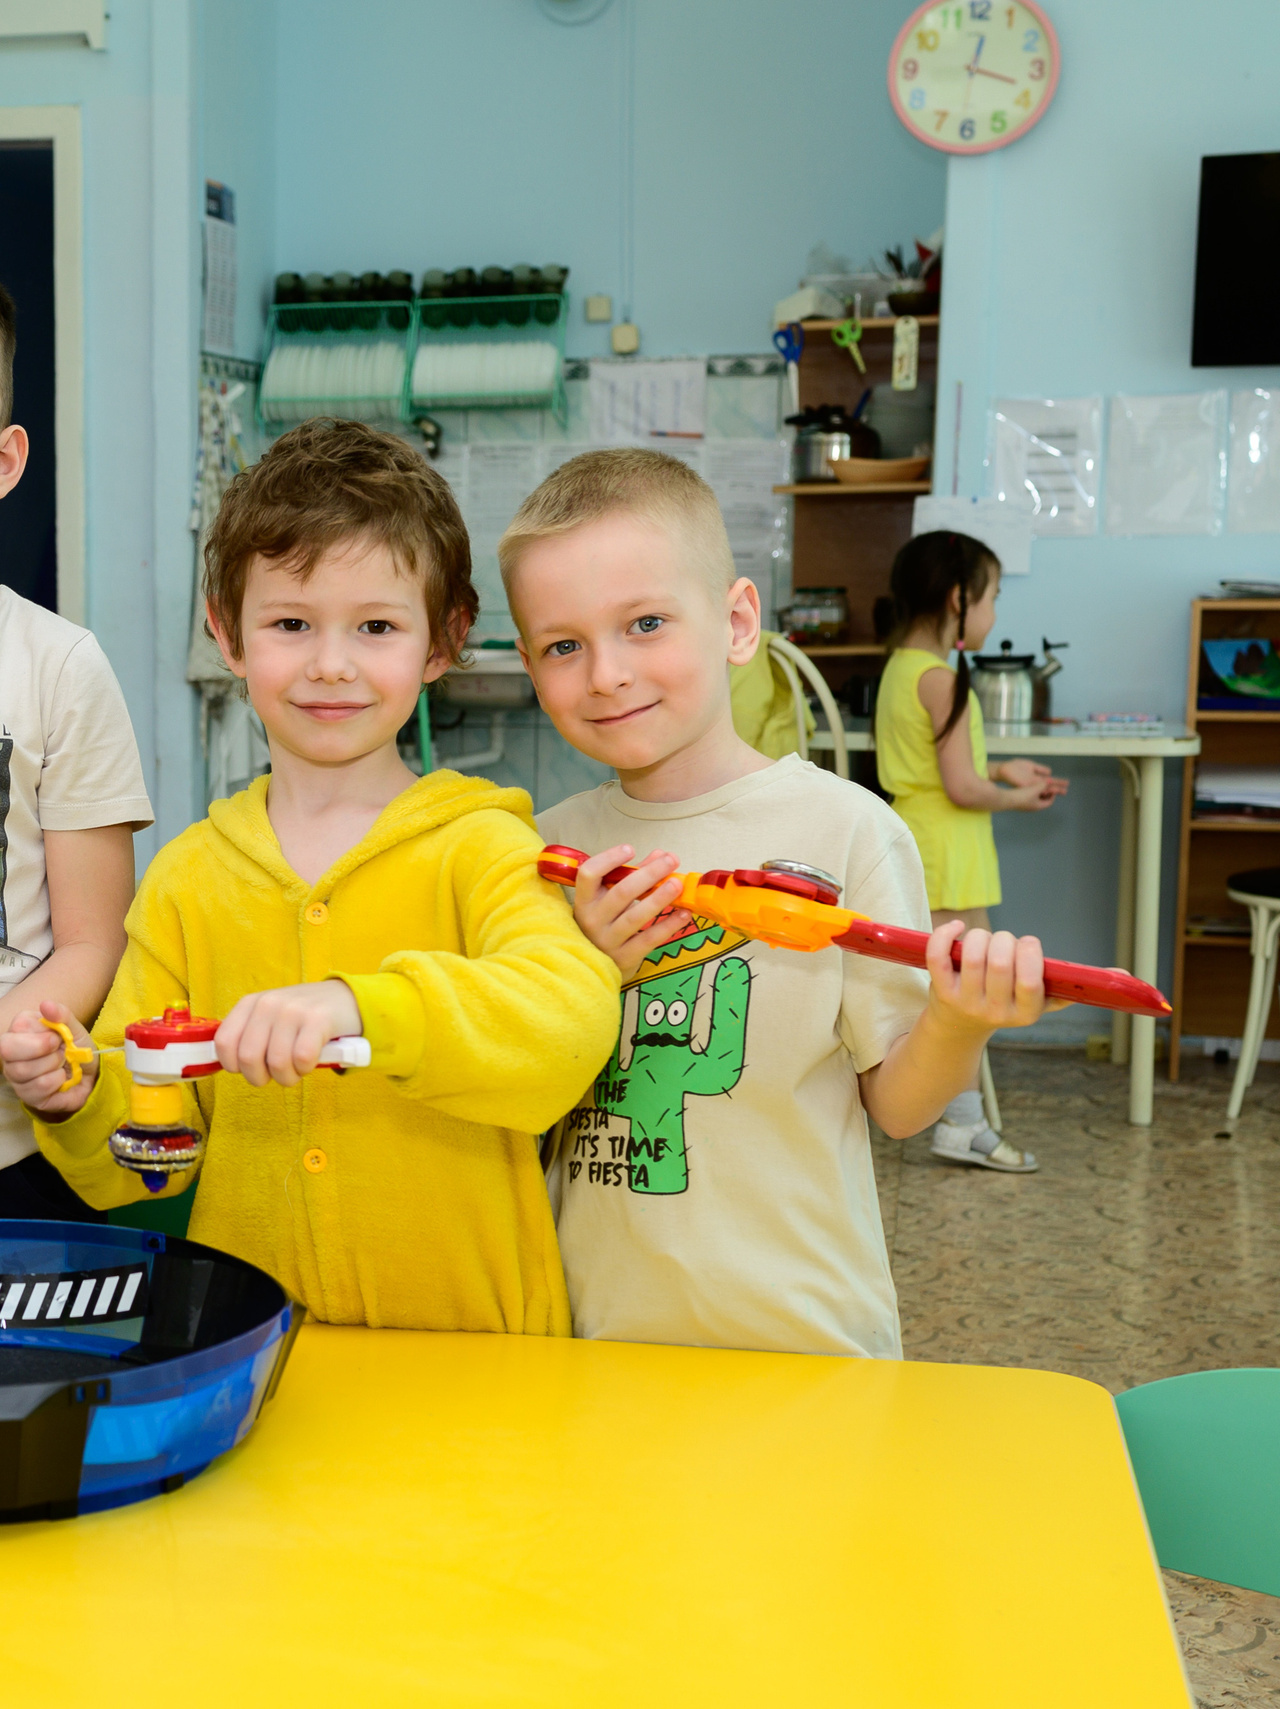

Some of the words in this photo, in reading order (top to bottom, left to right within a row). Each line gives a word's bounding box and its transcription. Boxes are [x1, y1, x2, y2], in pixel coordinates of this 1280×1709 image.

[942, 8, 962, 30] 11
[970, 0, 991, 21] 12
[1006, 7, 1015, 29] 1
[917, 29, 939, 52] 10
[1023, 29, 1038, 52] 2
[903, 58, 918, 81] 9
[1029, 58, 1045, 81] 3
[910, 88, 925, 110] 8
[1014, 89, 1030, 110] 4
[934, 109, 949, 131] 7
[959, 119, 974, 140] 6
[990, 111, 1007, 133] 5
[598, 1078, 631, 1104] THE
[574, 1132, 599, 1158] IT'S
[608, 1135, 669, 1162] TIME
[589, 1161, 649, 1188] FIESTA
